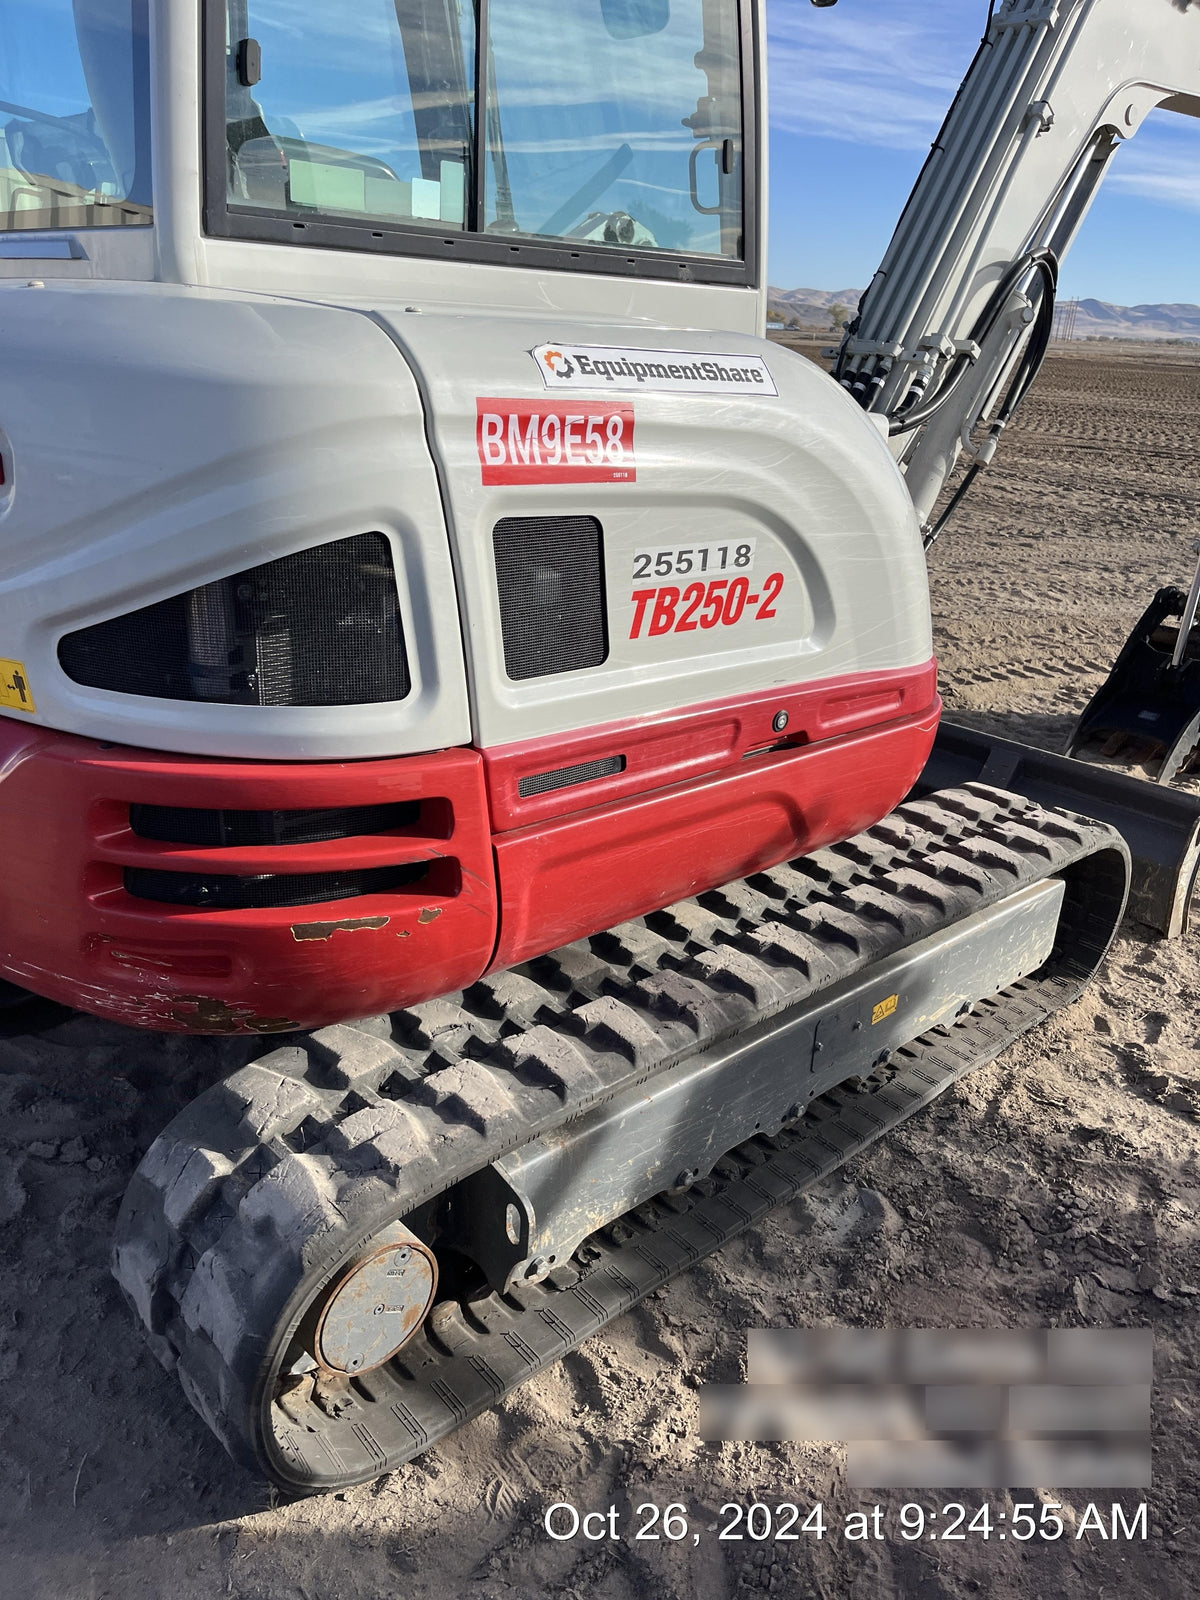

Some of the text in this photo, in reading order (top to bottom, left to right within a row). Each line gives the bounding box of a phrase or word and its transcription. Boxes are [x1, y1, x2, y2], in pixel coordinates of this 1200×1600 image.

[574, 355, 764, 383] EquipmentShare
[481, 414, 623, 466] BM9E58
[632, 544, 751, 579] 255118
[629, 572, 784, 639] TB250-2
